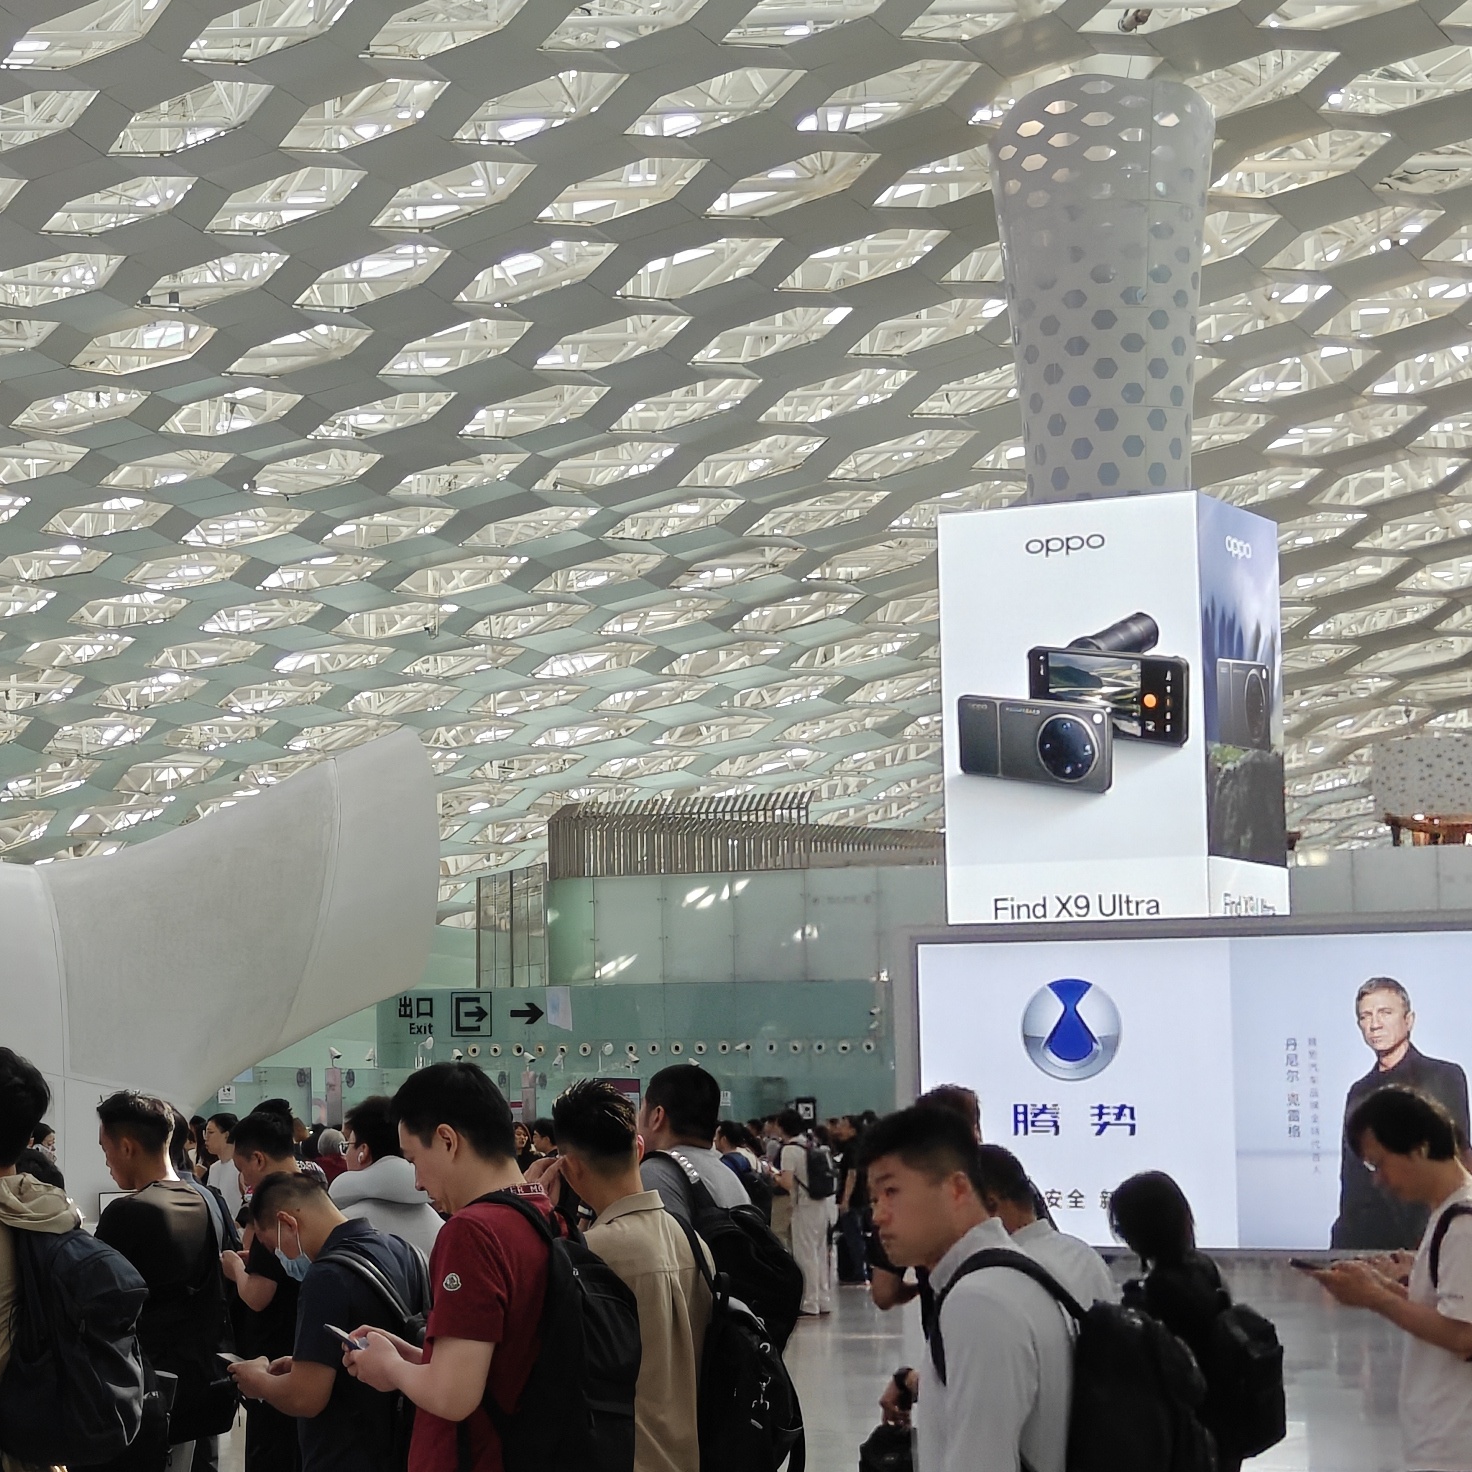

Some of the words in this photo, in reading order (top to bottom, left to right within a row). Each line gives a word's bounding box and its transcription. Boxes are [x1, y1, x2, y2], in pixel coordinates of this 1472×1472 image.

[1025, 533, 1105, 558] oppo
[1225, 534, 1252, 560] oppo
[993, 898, 1047, 920] Find
[1055, 895, 1090, 919] X9
[1098, 894, 1161, 916] Ultra
[399, 996, 433, 1018] 出口
[409, 1022, 433, 1035] Exit
[1285, 1037, 1300, 1083] 丹尼尔
[1013, 1103, 1136, 1136] 腾势
